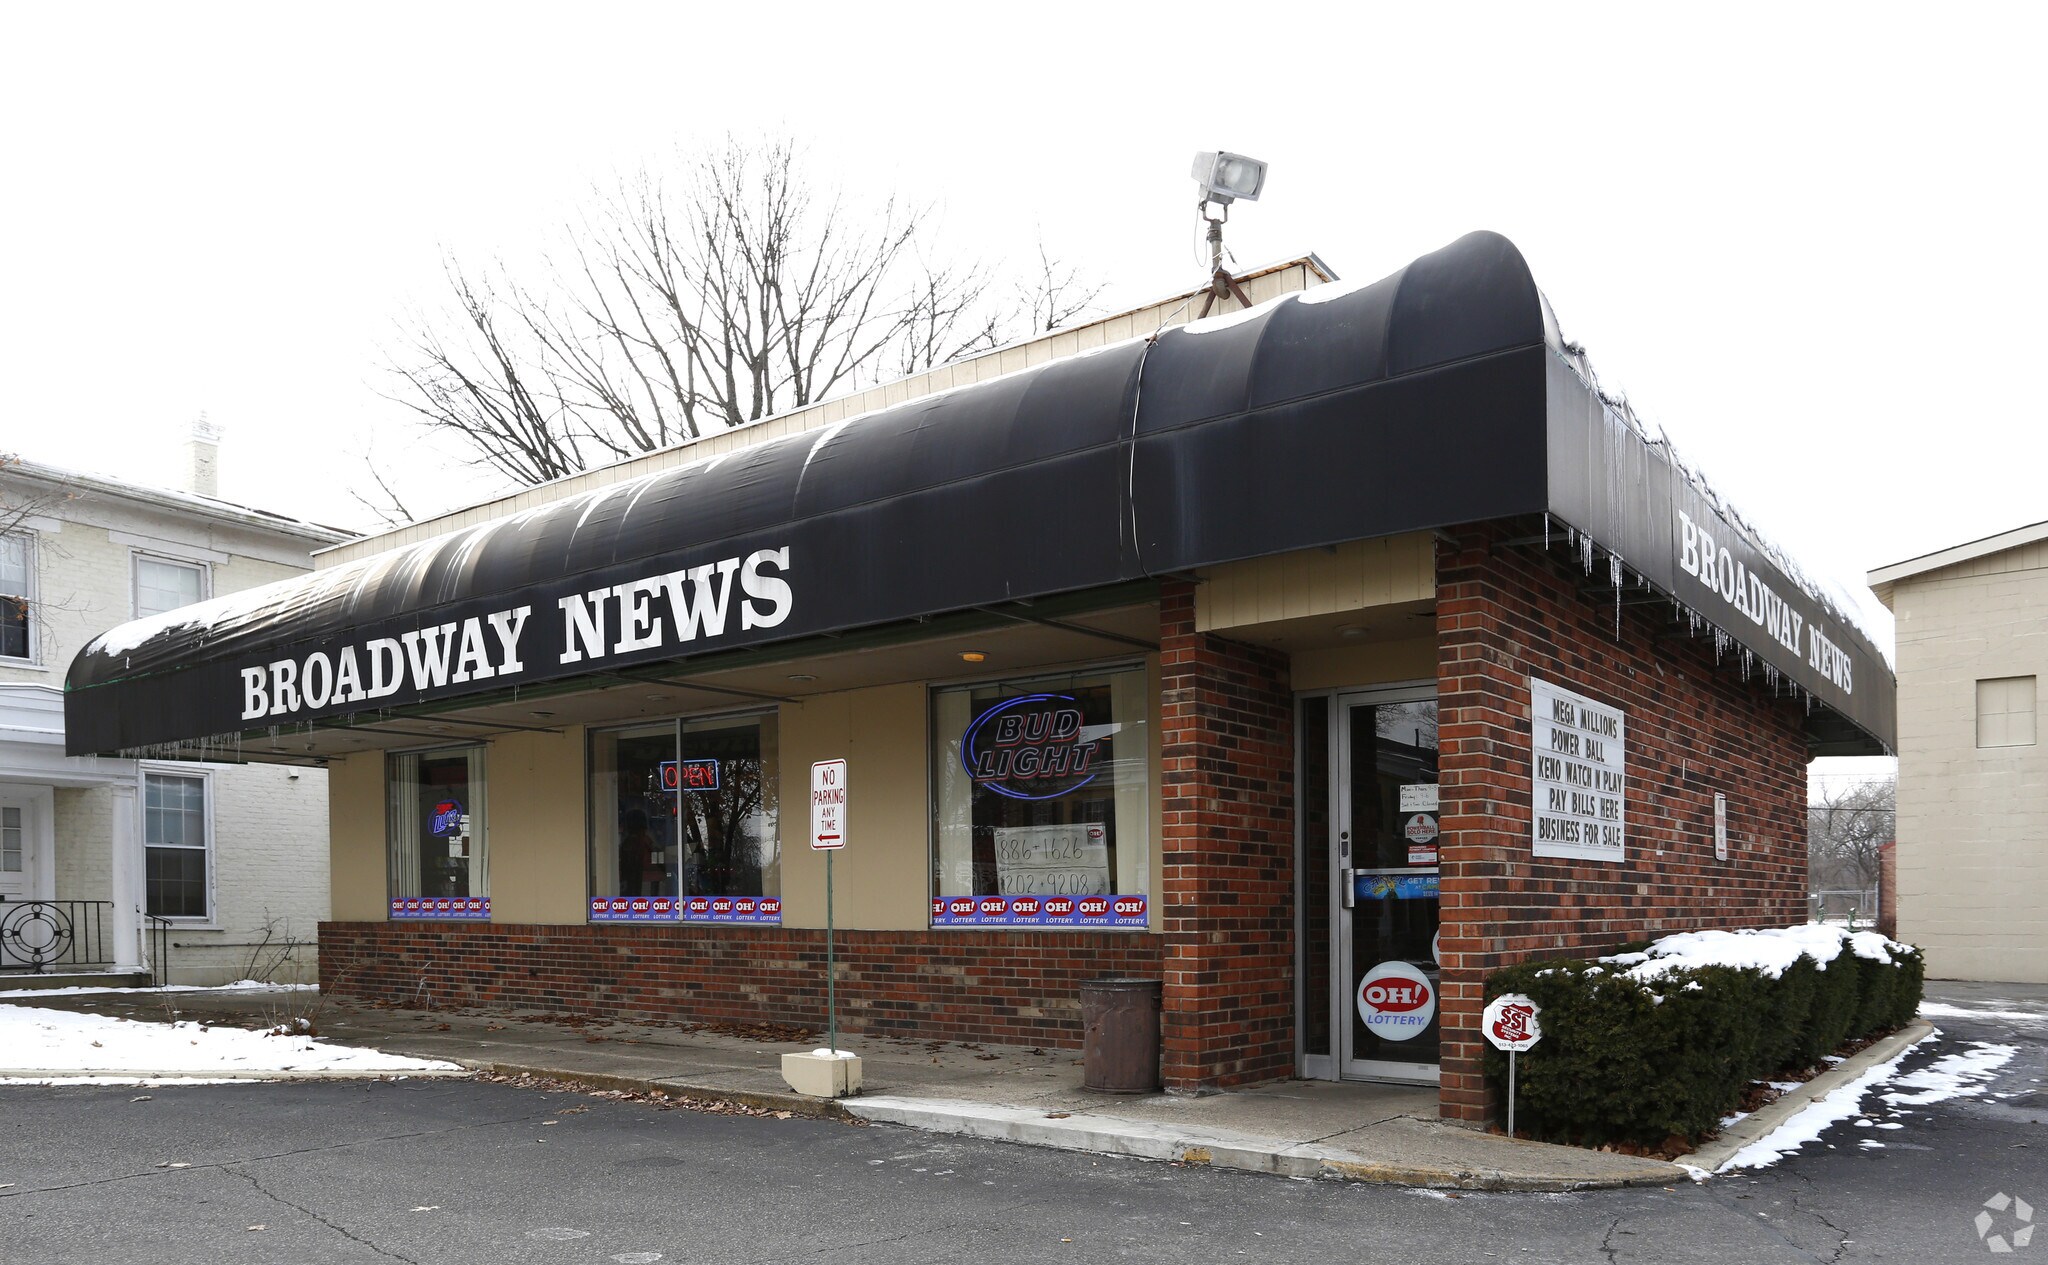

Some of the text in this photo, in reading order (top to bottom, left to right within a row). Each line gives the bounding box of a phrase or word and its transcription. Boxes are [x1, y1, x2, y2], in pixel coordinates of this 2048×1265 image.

[1678, 509, 1852, 695] BROADWAY NEWS
[240, 546, 794, 721] BROADWAY NEWS
[995, 709, 1083, 747] BUD
[1552, 698, 1617, 739] MEGA MILLIONS
[1551, 728, 1604, 762] POWER BALL
[975, 742, 1099, 781] LIGHT
[665, 767, 713, 787] OPEN
[822, 769, 835, 785] NO
[1538, 755, 1622, 794] KENO WATCH N PLAY
[814, 788, 844, 806] PARKING
[1549, 787, 1619, 820] PAY BILLS HERE
[822, 807, 835, 818] ANY
[821, 820, 836, 831] TIME
[1539, 817, 1620, 847] BUSINESS FOR SALE
[1408, 877, 1424, 885] GET
[592, 901, 608, 910] OH!
[612, 901, 628, 910] OH!
[632, 901, 649, 910] OH!
[653, 901, 670, 910] OH!
[690, 901, 708, 911] OH!
[713, 901, 731, 911] OH!
[736, 901, 755, 911] OH!
[760, 901, 779, 911] OH!
[933, 901, 1143, 912] H! OH! OH! OH! OH! OH! OH!
[1366, 984, 1422, 1004] OH!
[1367, 1014, 1424, 1026] LOTTERY
[1501, 1008, 1526, 1032] SSI
